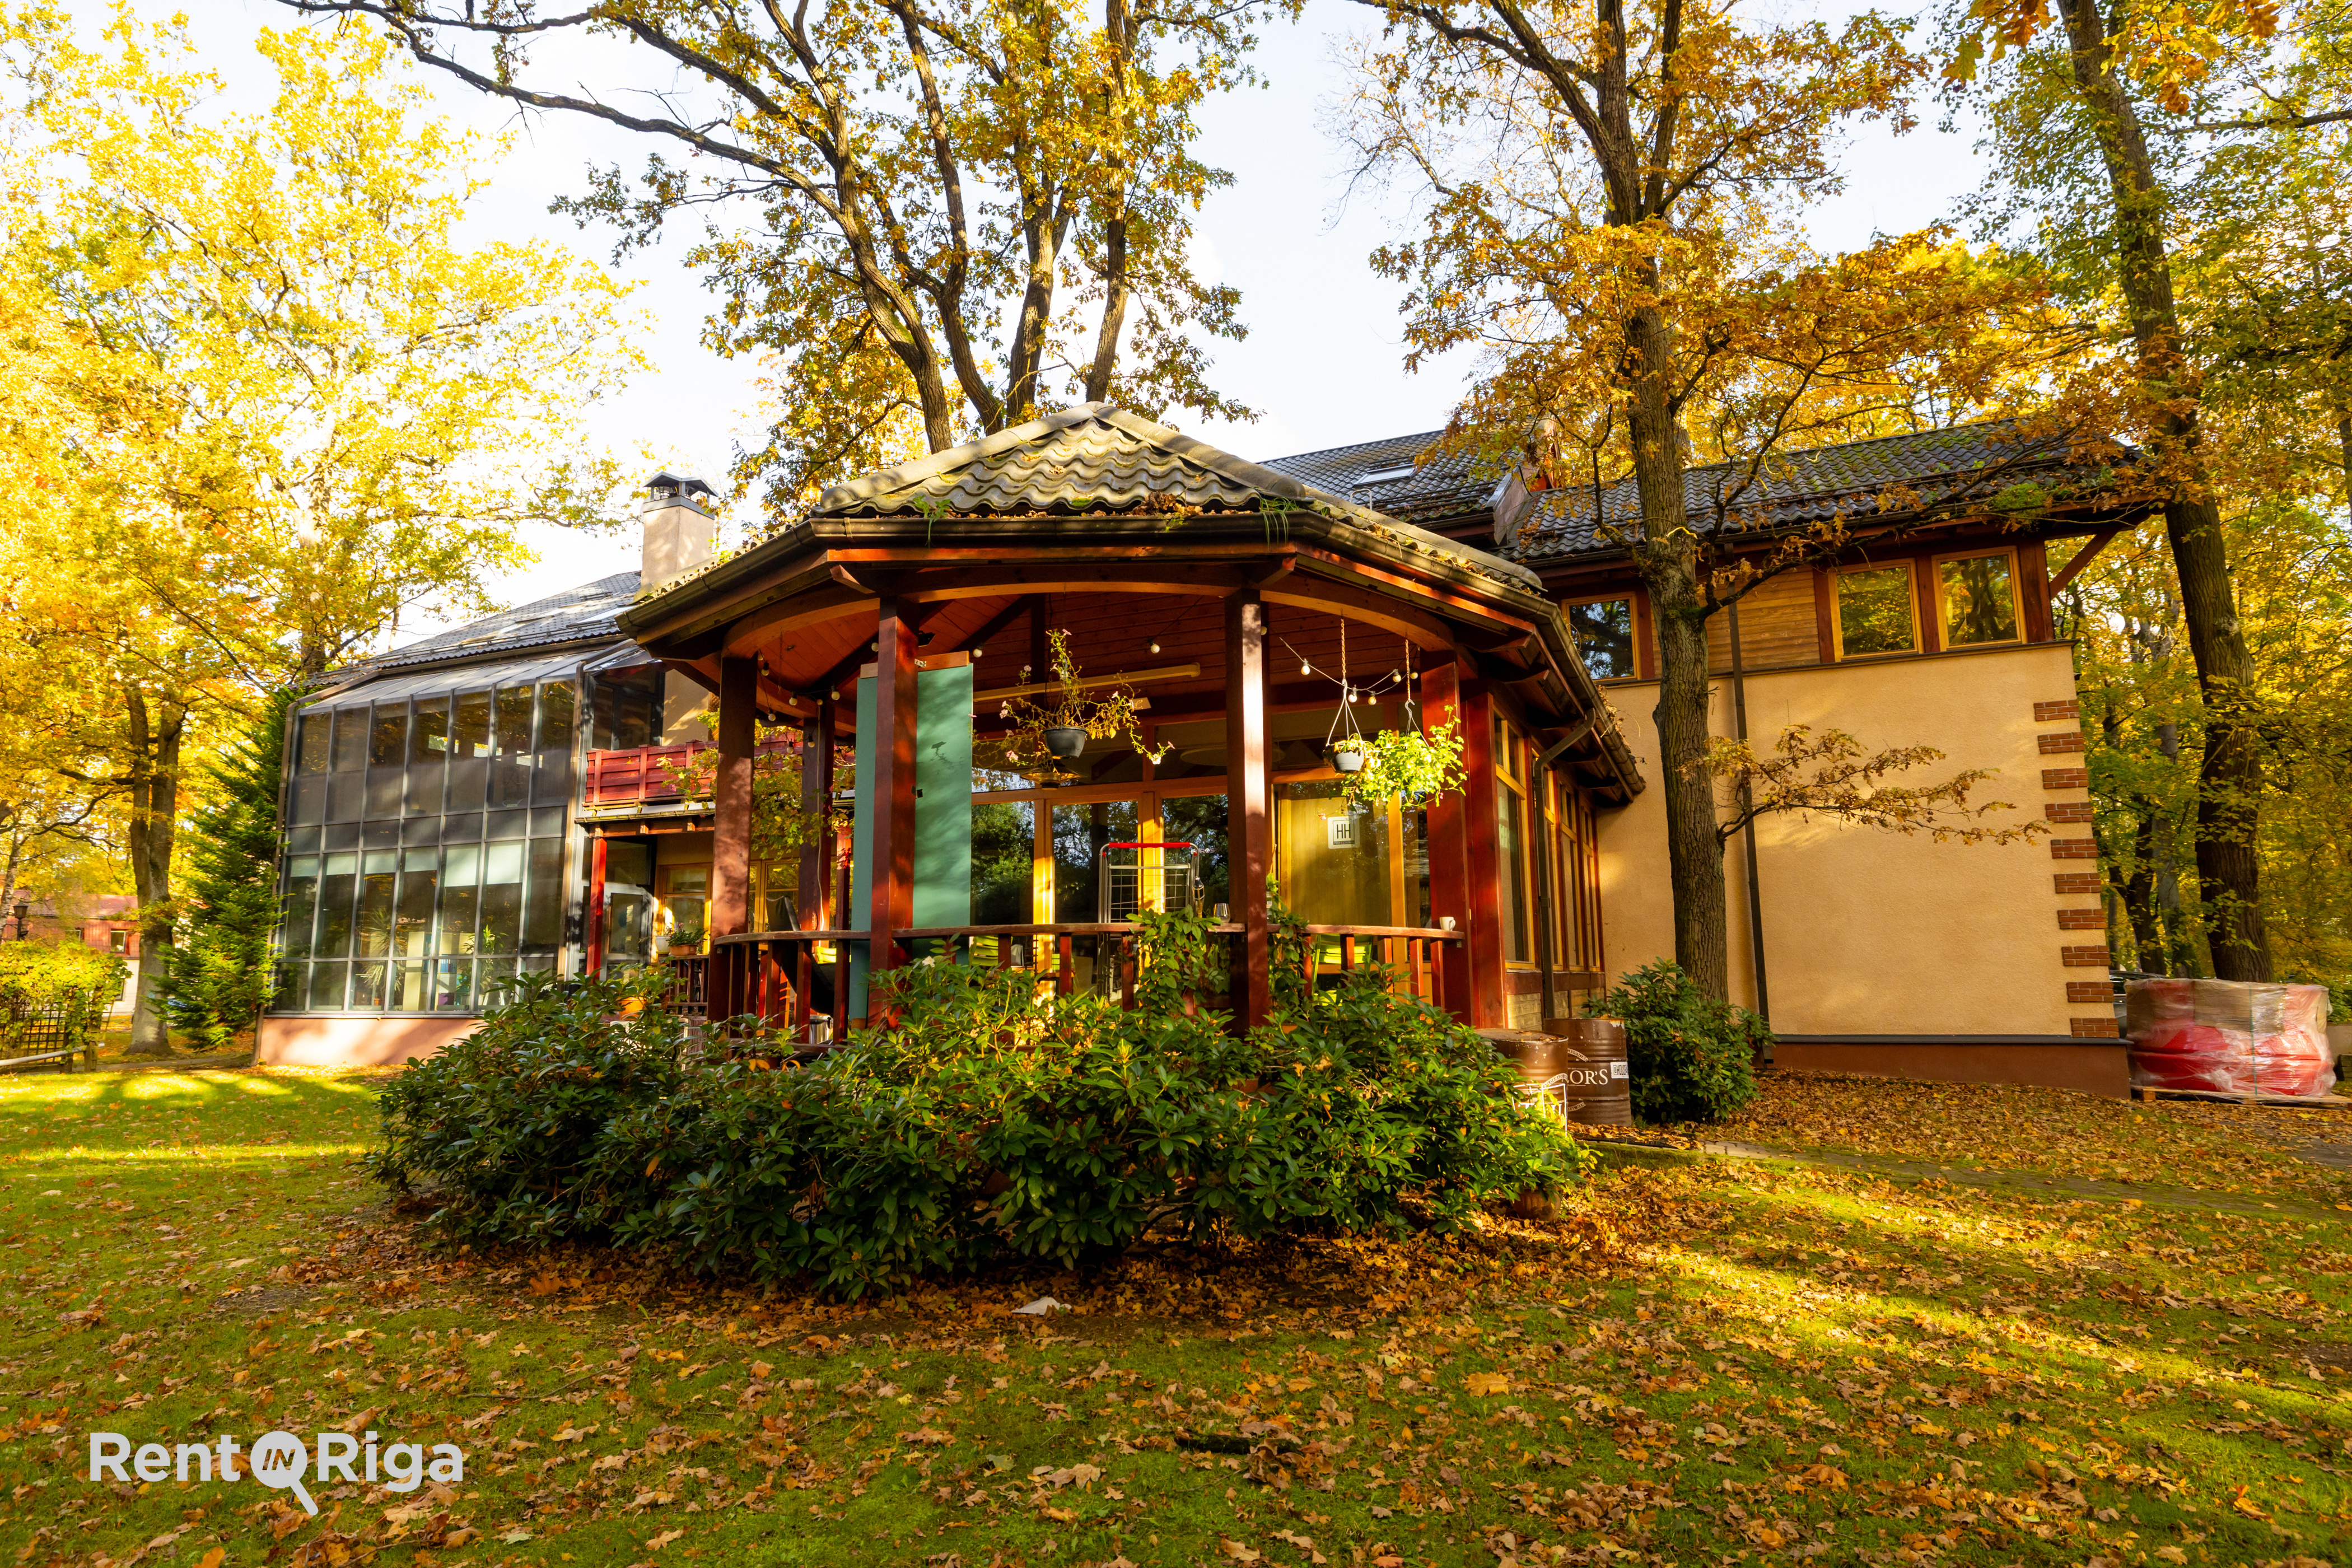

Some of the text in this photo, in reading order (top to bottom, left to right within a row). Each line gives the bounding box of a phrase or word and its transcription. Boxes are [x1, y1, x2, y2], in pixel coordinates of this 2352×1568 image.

[1336, 823, 1351, 839] HH
[1567, 1049, 1588, 1062] ROOMING
[1569, 1068, 1608, 1085] OR'S
